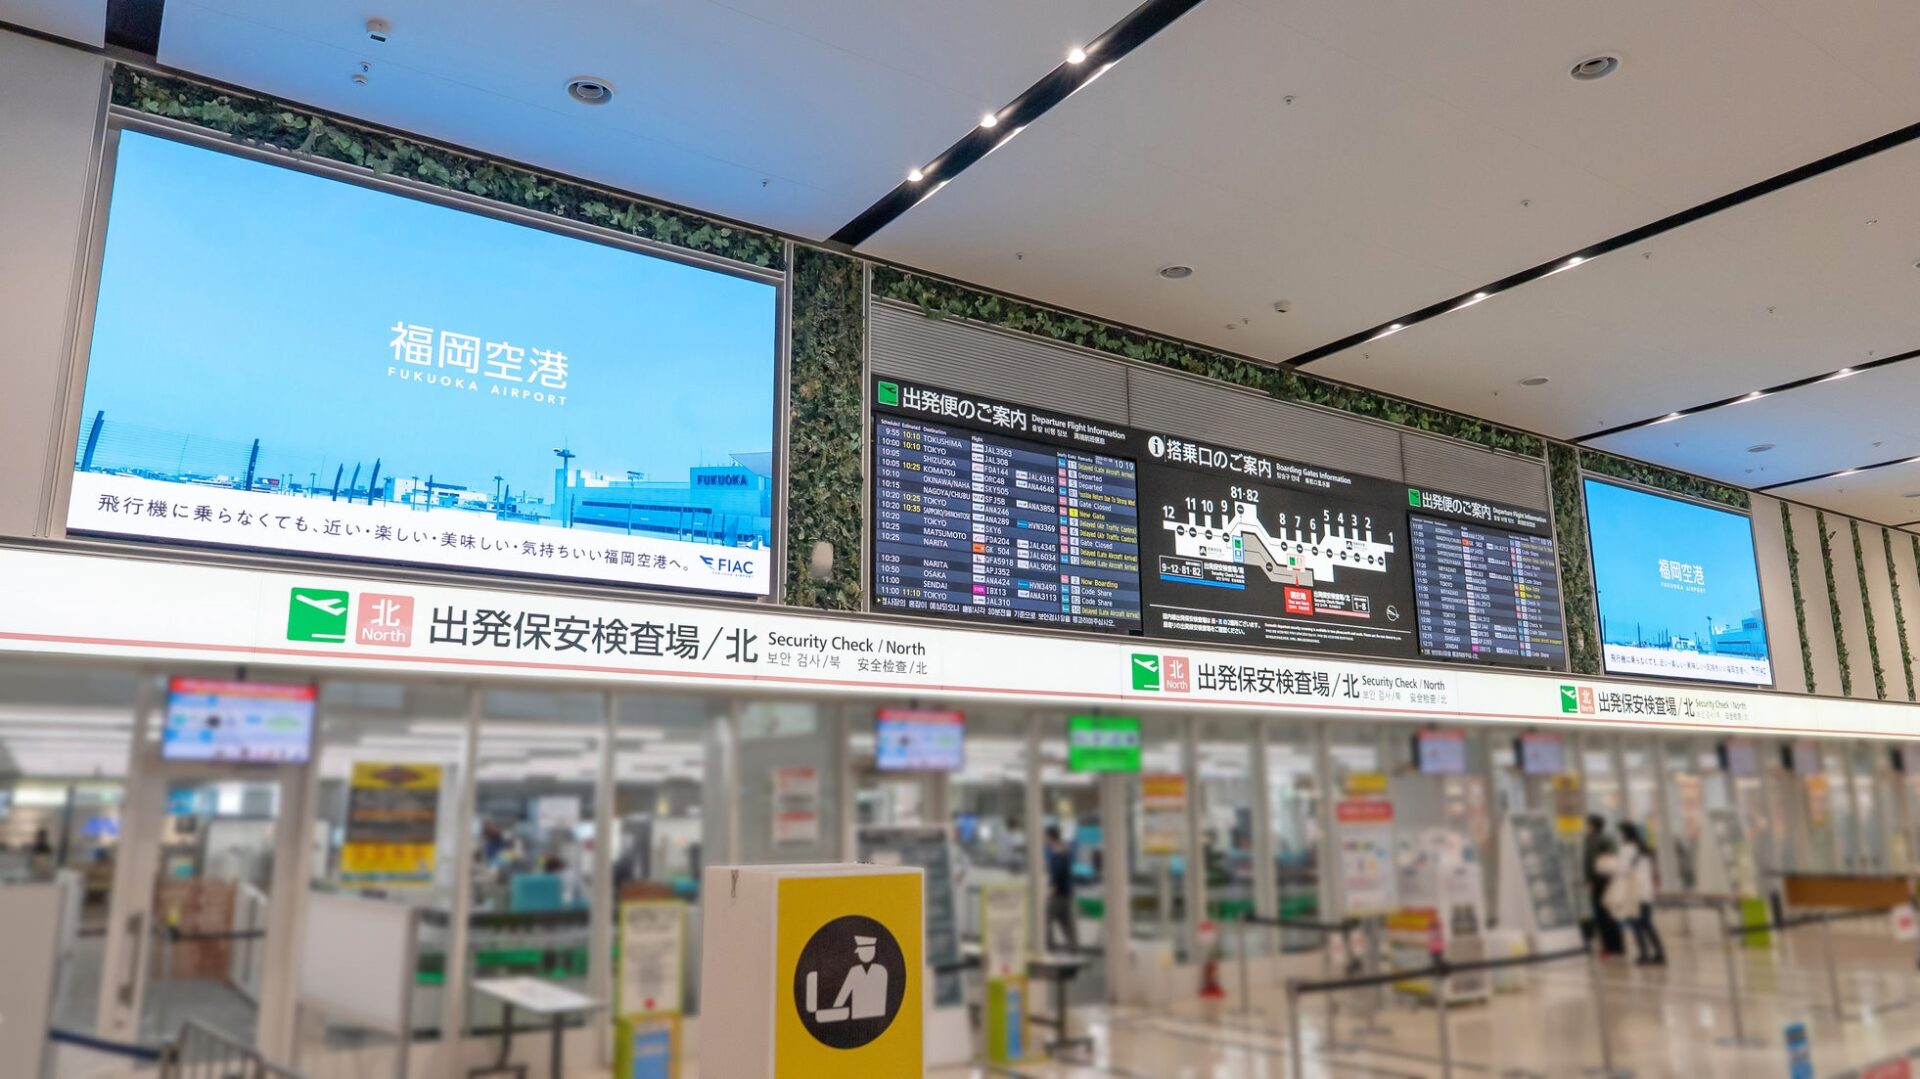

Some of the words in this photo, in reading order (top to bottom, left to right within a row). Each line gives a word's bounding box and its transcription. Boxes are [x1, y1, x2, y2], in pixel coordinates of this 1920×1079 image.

[390, 321, 569, 390] 福岡空港
[387, 366, 478, 392] FUKUOKA
[491, 384, 567, 406] AIRPORT
[902, 386, 1027, 431] 出発便のご案内
[1032, 414, 1066, 428] Departure
[1067, 421, 1086, 432] Flight
[1087, 425, 1126, 440] Information
[885, 428, 900, 436] 9:55
[903, 431, 920, 440] 10:10
[923, 435, 962, 448] TOKUSHIMA
[984, 445, 1012, 457] JAL3563
[882, 438, 900, 447] 10:00
[903, 441, 920, 450] 10:10
[923, 445, 946, 455] TOKYO
[984, 456, 1009, 466] JAL308
[1078, 473, 1102, 482] Departed
[882, 458, 900, 467] 10:05
[903, 462, 920, 471] 10:25
[923, 466, 956, 477] KOMATSU
[1166, 439, 1272, 479] 搭乗口のご案内
[882, 448, 900, 457] 10:05
[923, 455, 956, 467] SHIZUOKA
[984, 466, 1009, 476] FDA144
[1028, 472, 1055, 484] JAL4315
[1079, 482, 1103, 492] Departed
[1276, 463, 1302, 476] Boarding
[1303, 468, 1319, 478] Gates
[1319, 471, 1352, 485] Information
[697, 474, 748, 487] FUKUOKA
[882, 480, 900, 489] 10:15
[923, 486, 971, 500] NAGOYA/CHUBU
[882, 469, 900, 478] 10:10
[923, 475, 970, 489] OKINAWA/NAHA
[984, 485, 1009, 496] SKY505
[1079, 501, 1092, 509] Gate
[1094, 502, 1112, 512] Closed
[882, 490, 900, 499] 10:20
[903, 493, 921, 502] 10:25
[923, 496, 947, 506] TOKYO
[985, 506, 1010, 516] ANA246
[1162, 505, 1176, 520] 12
[1185, 497, 1197, 511] 11
[1201, 500, 1214, 513] 10
[1221, 500, 1228, 512] 9
[1422, 492, 1491, 521] 出発便のご案内
[882, 501, 900, 510] 10:20
[903, 504, 921, 513] 10:35
[985, 516, 1010, 526] ANA289
[1279, 513, 1286, 525] 8
[1295, 516, 1301, 528] 7
[1323, 509, 1330, 521] 5
[1337, 512, 1344, 524] 4
[1351, 514, 1358, 527] 3
[1365, 517, 1372, 529] 2
[882, 511, 900, 520] 10:20
[923, 517, 947, 527] TOKYO
[985, 526, 1002, 535] SKY6
[1080, 539, 1093, 548] Gate
[1095, 541, 1113, 550] Closed
[1309, 518, 1316, 531] 6
[882, 522, 900, 531] 10:25
[923, 528, 967, 540] MATSUMOTO
[985, 536, 1010, 546] FDA204
[1029, 541, 1056, 552] JAL4345
[882, 533, 900, 541] 10:25
[923, 538, 948, 548] NARITA
[1388, 532, 1393, 543] 1
[718, 558, 754, 575] FIAC
[881, 555, 900, 563] 10:30
[923, 560, 948, 569] NARITA
[985, 566, 1010, 576] APJ352
[1658, 559, 1704, 585] 福岡空港
[881, 565, 900, 573] 10:50
[923, 570, 947, 579] OSAKA
[985, 577, 1011, 586] ANA424
[1081, 588, 1095, 596] Code
[1097, 589, 1113, 598] Share
[881, 576, 900, 584] 11:00
[923, 580, 948, 590] SENDAI
[986, 587, 1007, 596] IBX13
[1082, 598, 1096, 606] Code
[1098, 599, 1113, 607] Share
[881, 587, 900, 595] 11:00
[903, 589, 921, 597] 11:10
[923, 591, 947, 600] TOKYO
[986, 597, 1011, 606] JAL310
[371, 598, 400, 627] 北
[362, 628, 406, 643] North
[768, 631, 827, 653] Security
[831, 636, 874, 653] Check
[886, 640, 926, 656] North
[766, 652, 791, 666] 보안
[1168, 659, 1184, 679] 北
[1166, 679, 1188, 690] North
[1362, 675, 1394, 689] Security
[1394, 677, 1418, 689] Check
[1423, 679, 1446, 691] North
